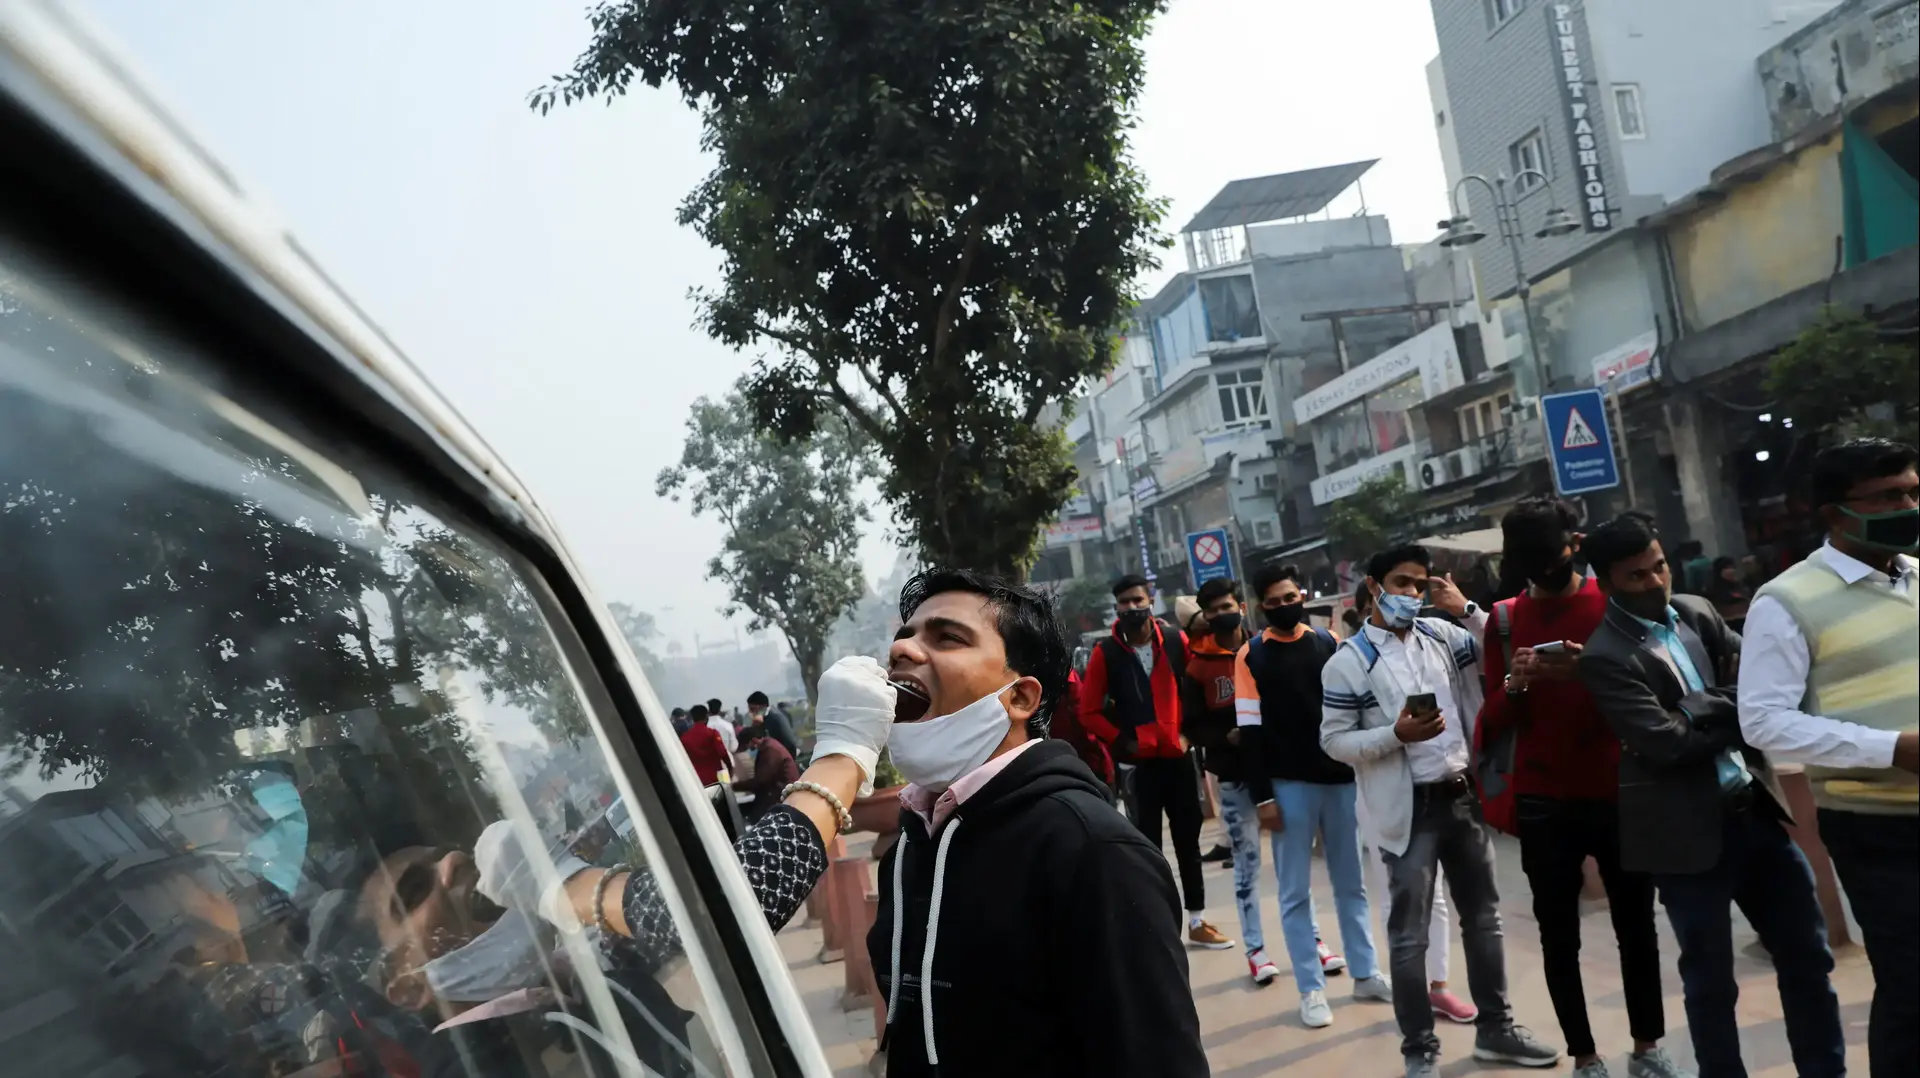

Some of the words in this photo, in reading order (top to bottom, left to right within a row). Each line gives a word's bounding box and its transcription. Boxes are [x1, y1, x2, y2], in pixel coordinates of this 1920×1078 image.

[1554, 4, 1584, 98] PUNEET
[1571, 103, 1608, 228] FASHIONS
[1347, 354, 1412, 393] CREATIONS
